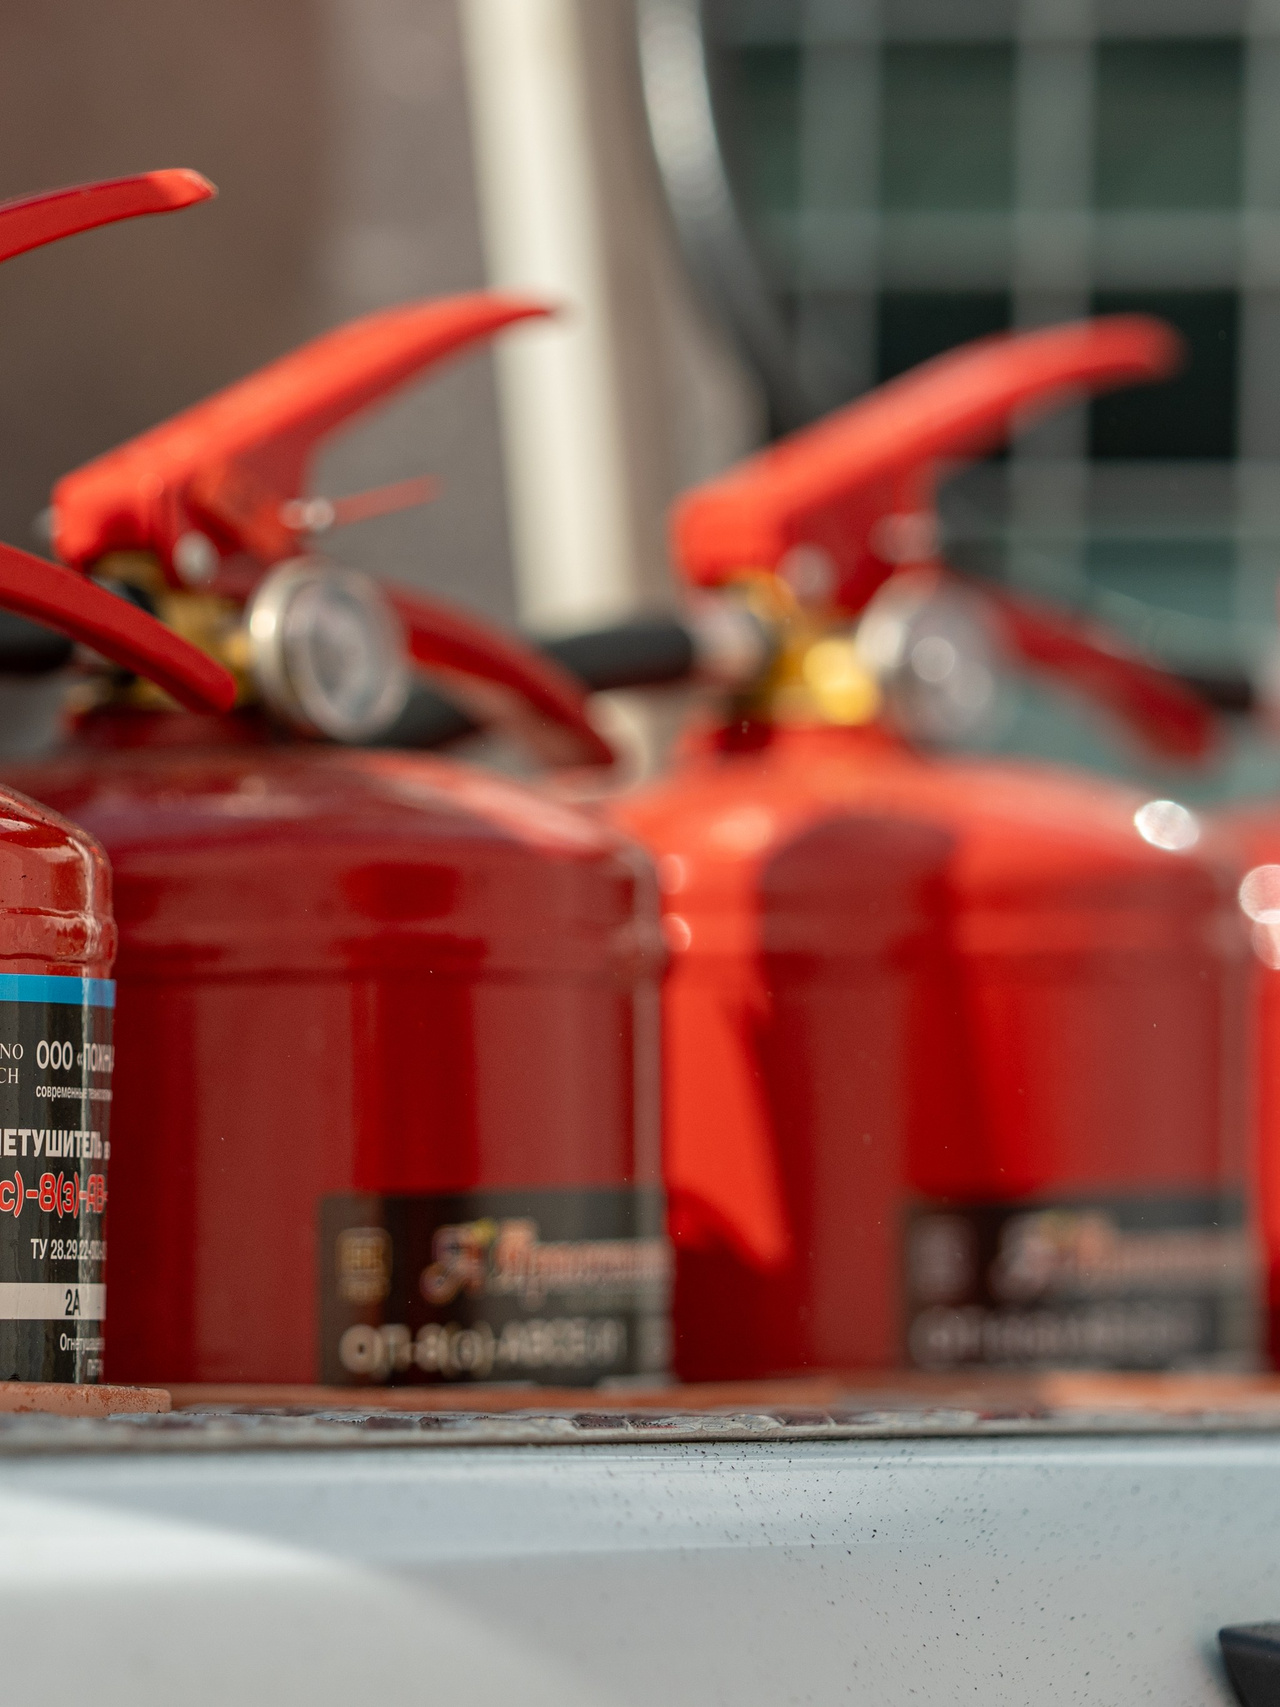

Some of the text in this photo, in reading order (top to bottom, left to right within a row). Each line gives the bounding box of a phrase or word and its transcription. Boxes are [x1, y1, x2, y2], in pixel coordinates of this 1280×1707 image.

[36, 1040, 73, 1070] ООО
[31, 1238, 48, 1260] ТУ
[64, 1288, 81, 1316] 2А
